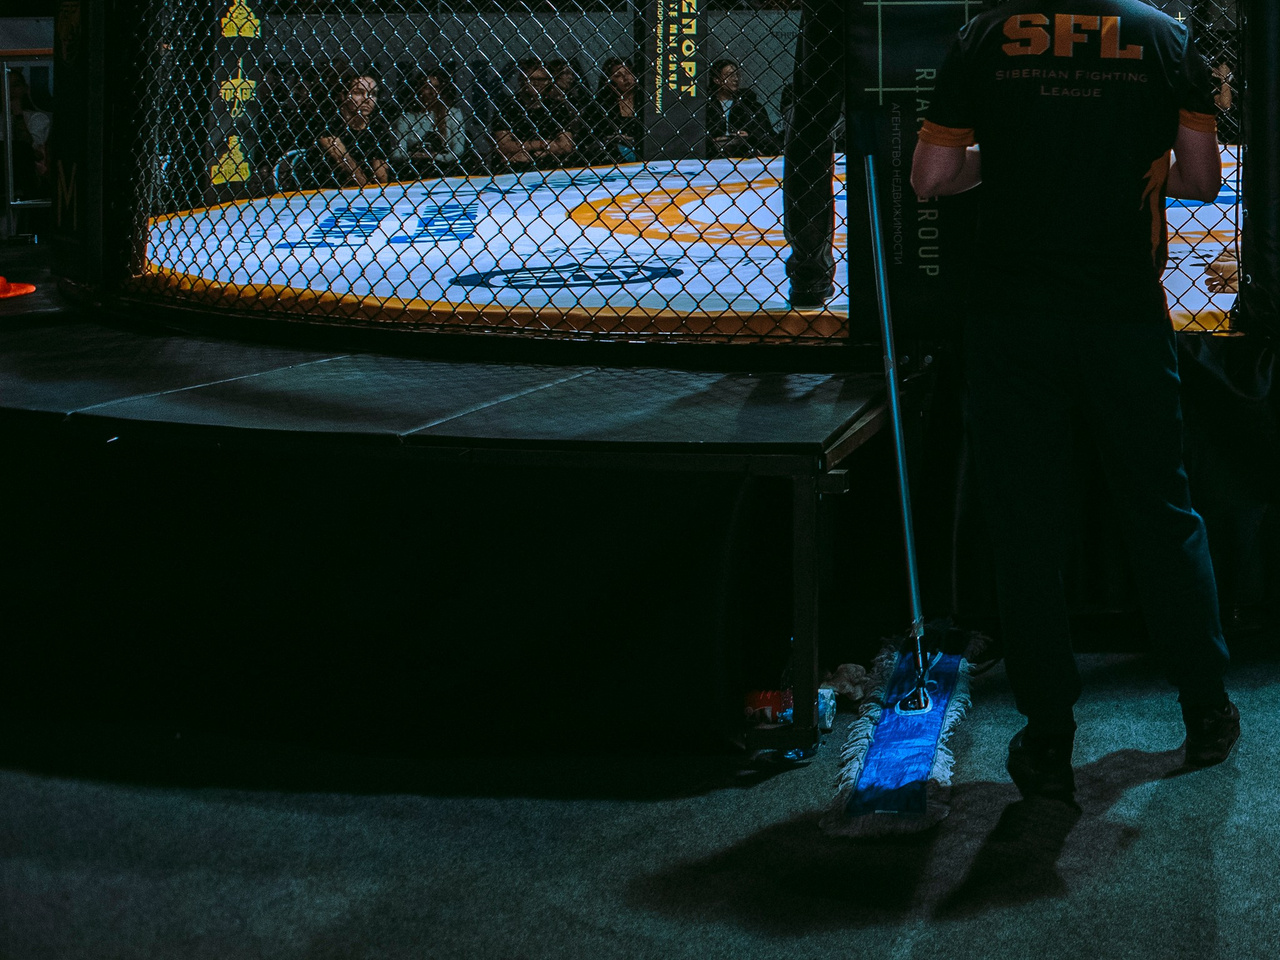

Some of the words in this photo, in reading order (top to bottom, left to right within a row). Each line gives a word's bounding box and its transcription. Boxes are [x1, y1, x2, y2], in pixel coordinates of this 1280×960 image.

[1001, 12, 1144, 61] SFL
[995, 68, 1069, 81] SIBERIAN
[1075, 69, 1149, 83] FIGHTING
[1040, 84, 1101, 98] LEAGUE
[891, 102, 902, 167] АГЕНТСТВО
[892, 169, 903, 265] НЕДВИЖИМОСТИ
